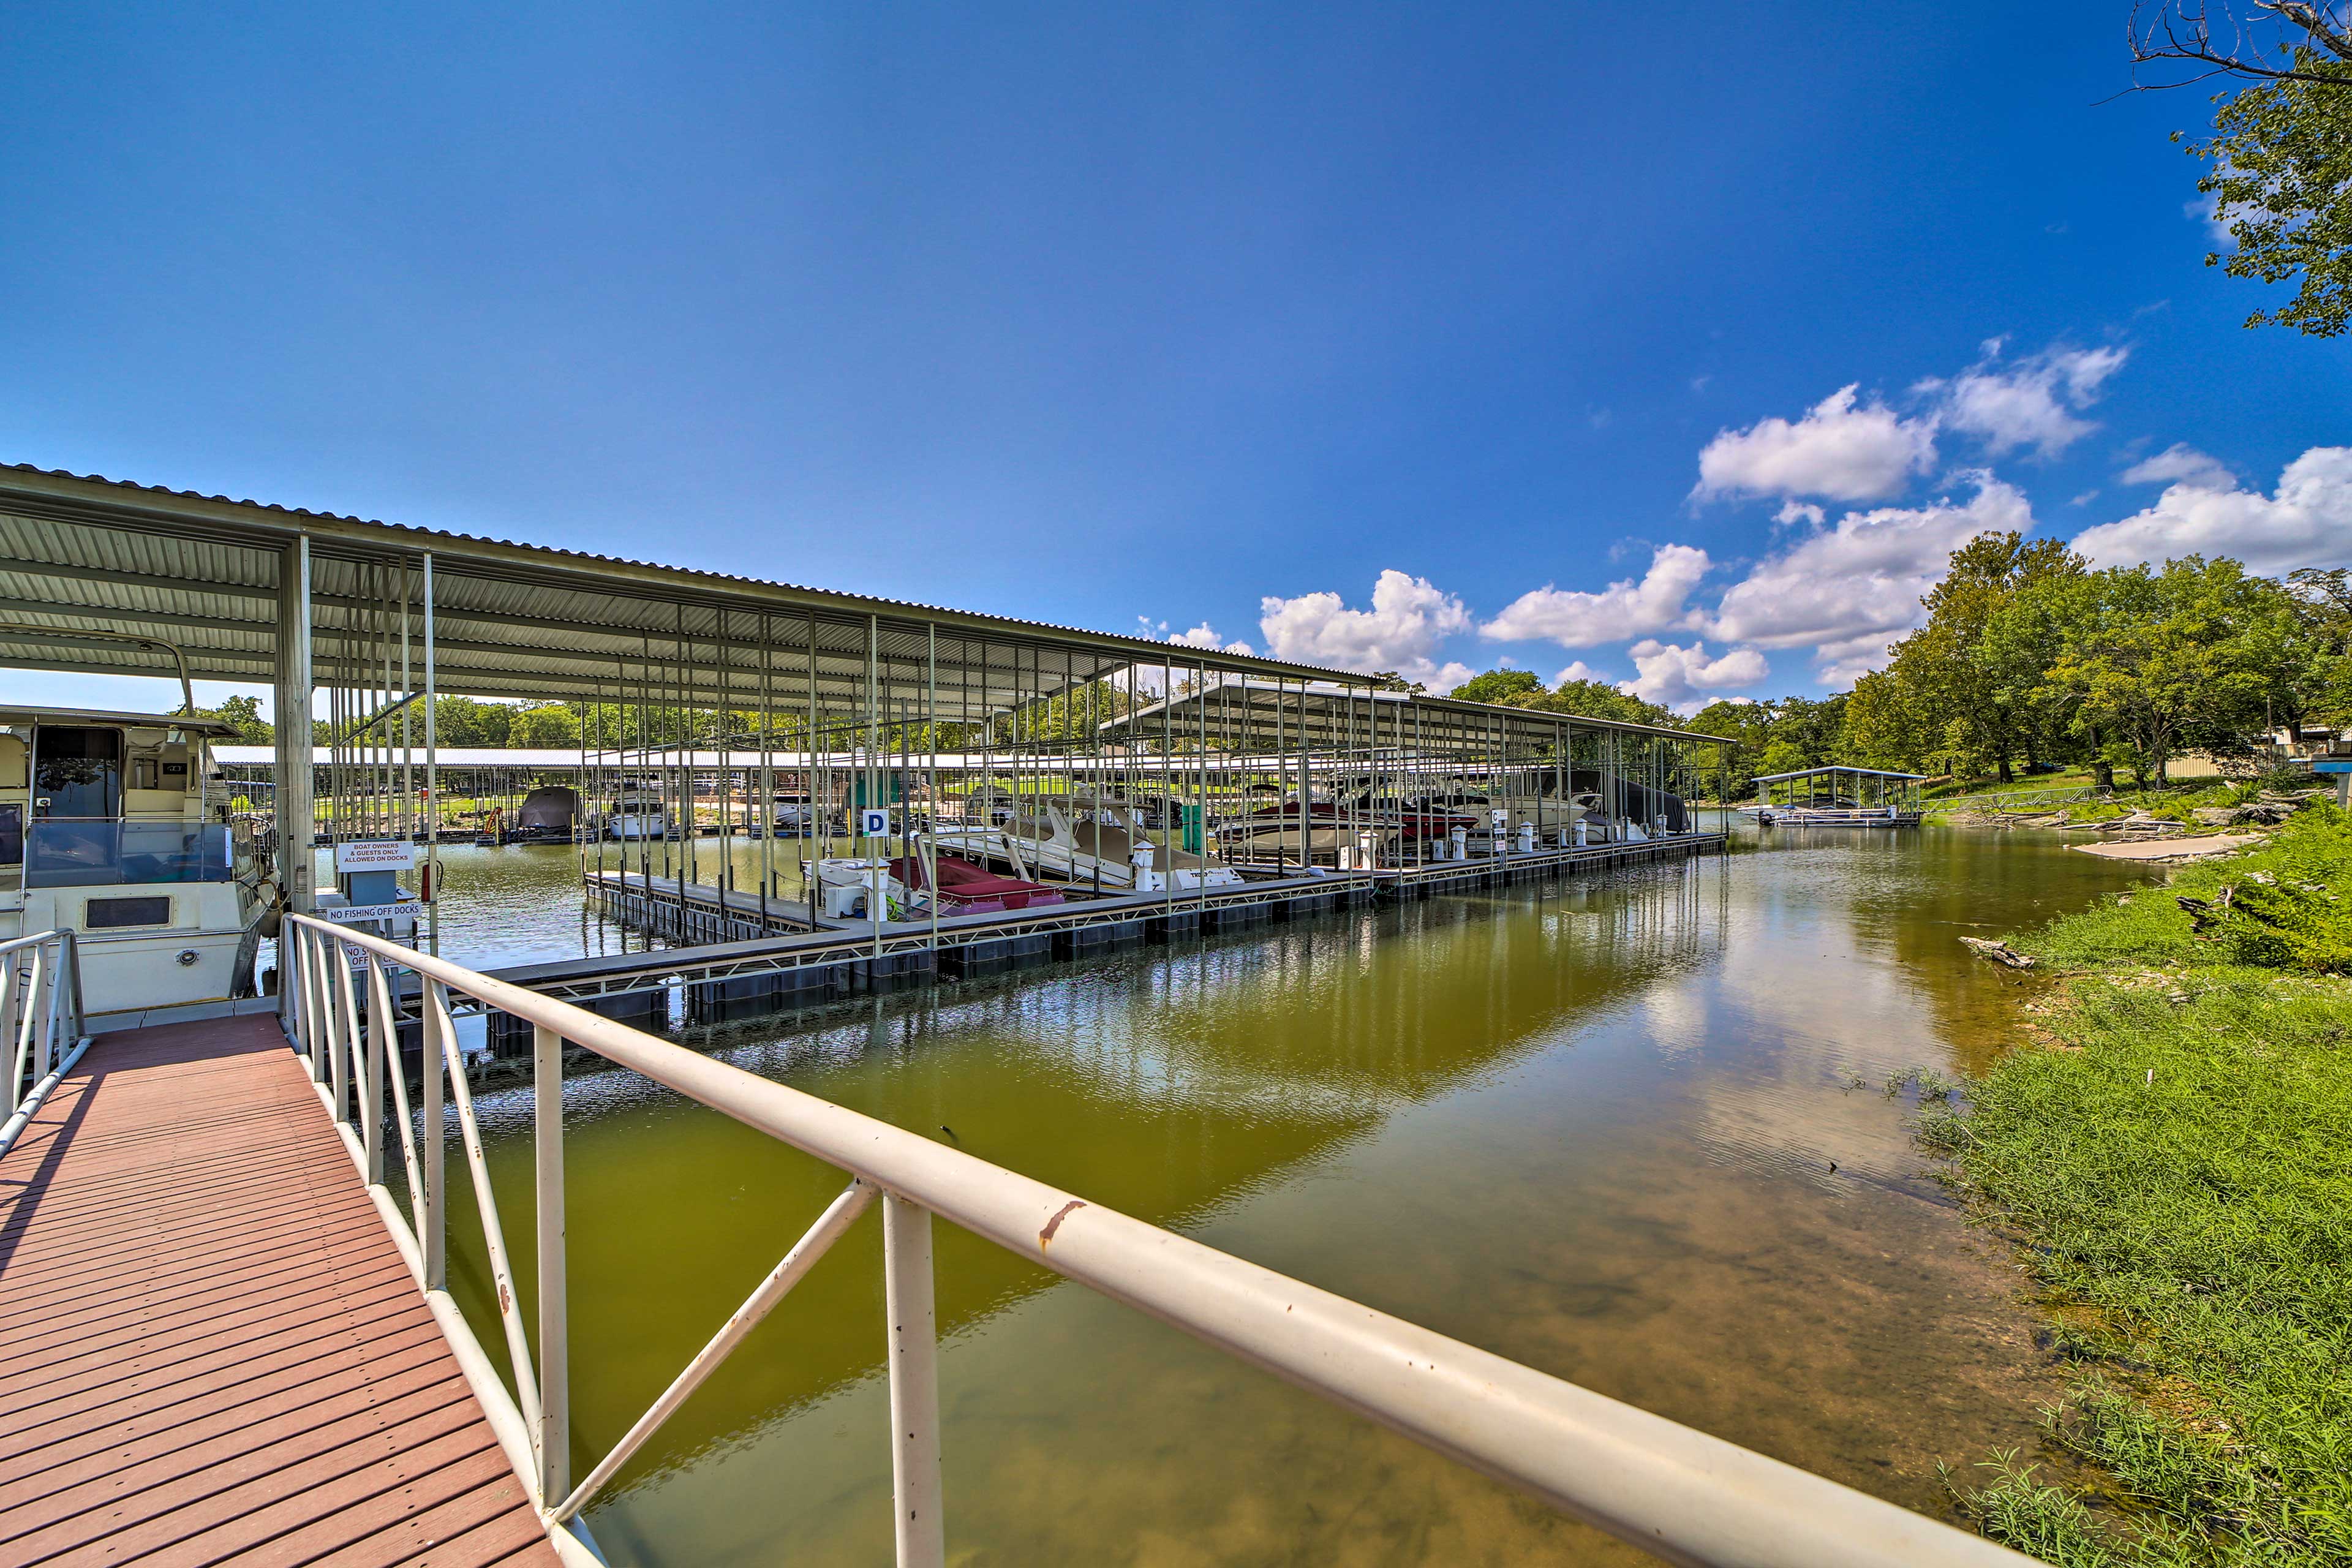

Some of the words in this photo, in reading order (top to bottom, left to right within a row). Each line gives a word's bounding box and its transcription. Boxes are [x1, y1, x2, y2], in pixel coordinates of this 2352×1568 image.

[1493, 812, 1498, 821] C
[869, 815, 884, 832] D
[331, 911, 342, 919] NO
[345, 908, 375, 918] FISHING
[377, 907, 393, 916] OFF
[394, 905, 419, 914] DOCKS
[352, 956, 369, 965] OFF
